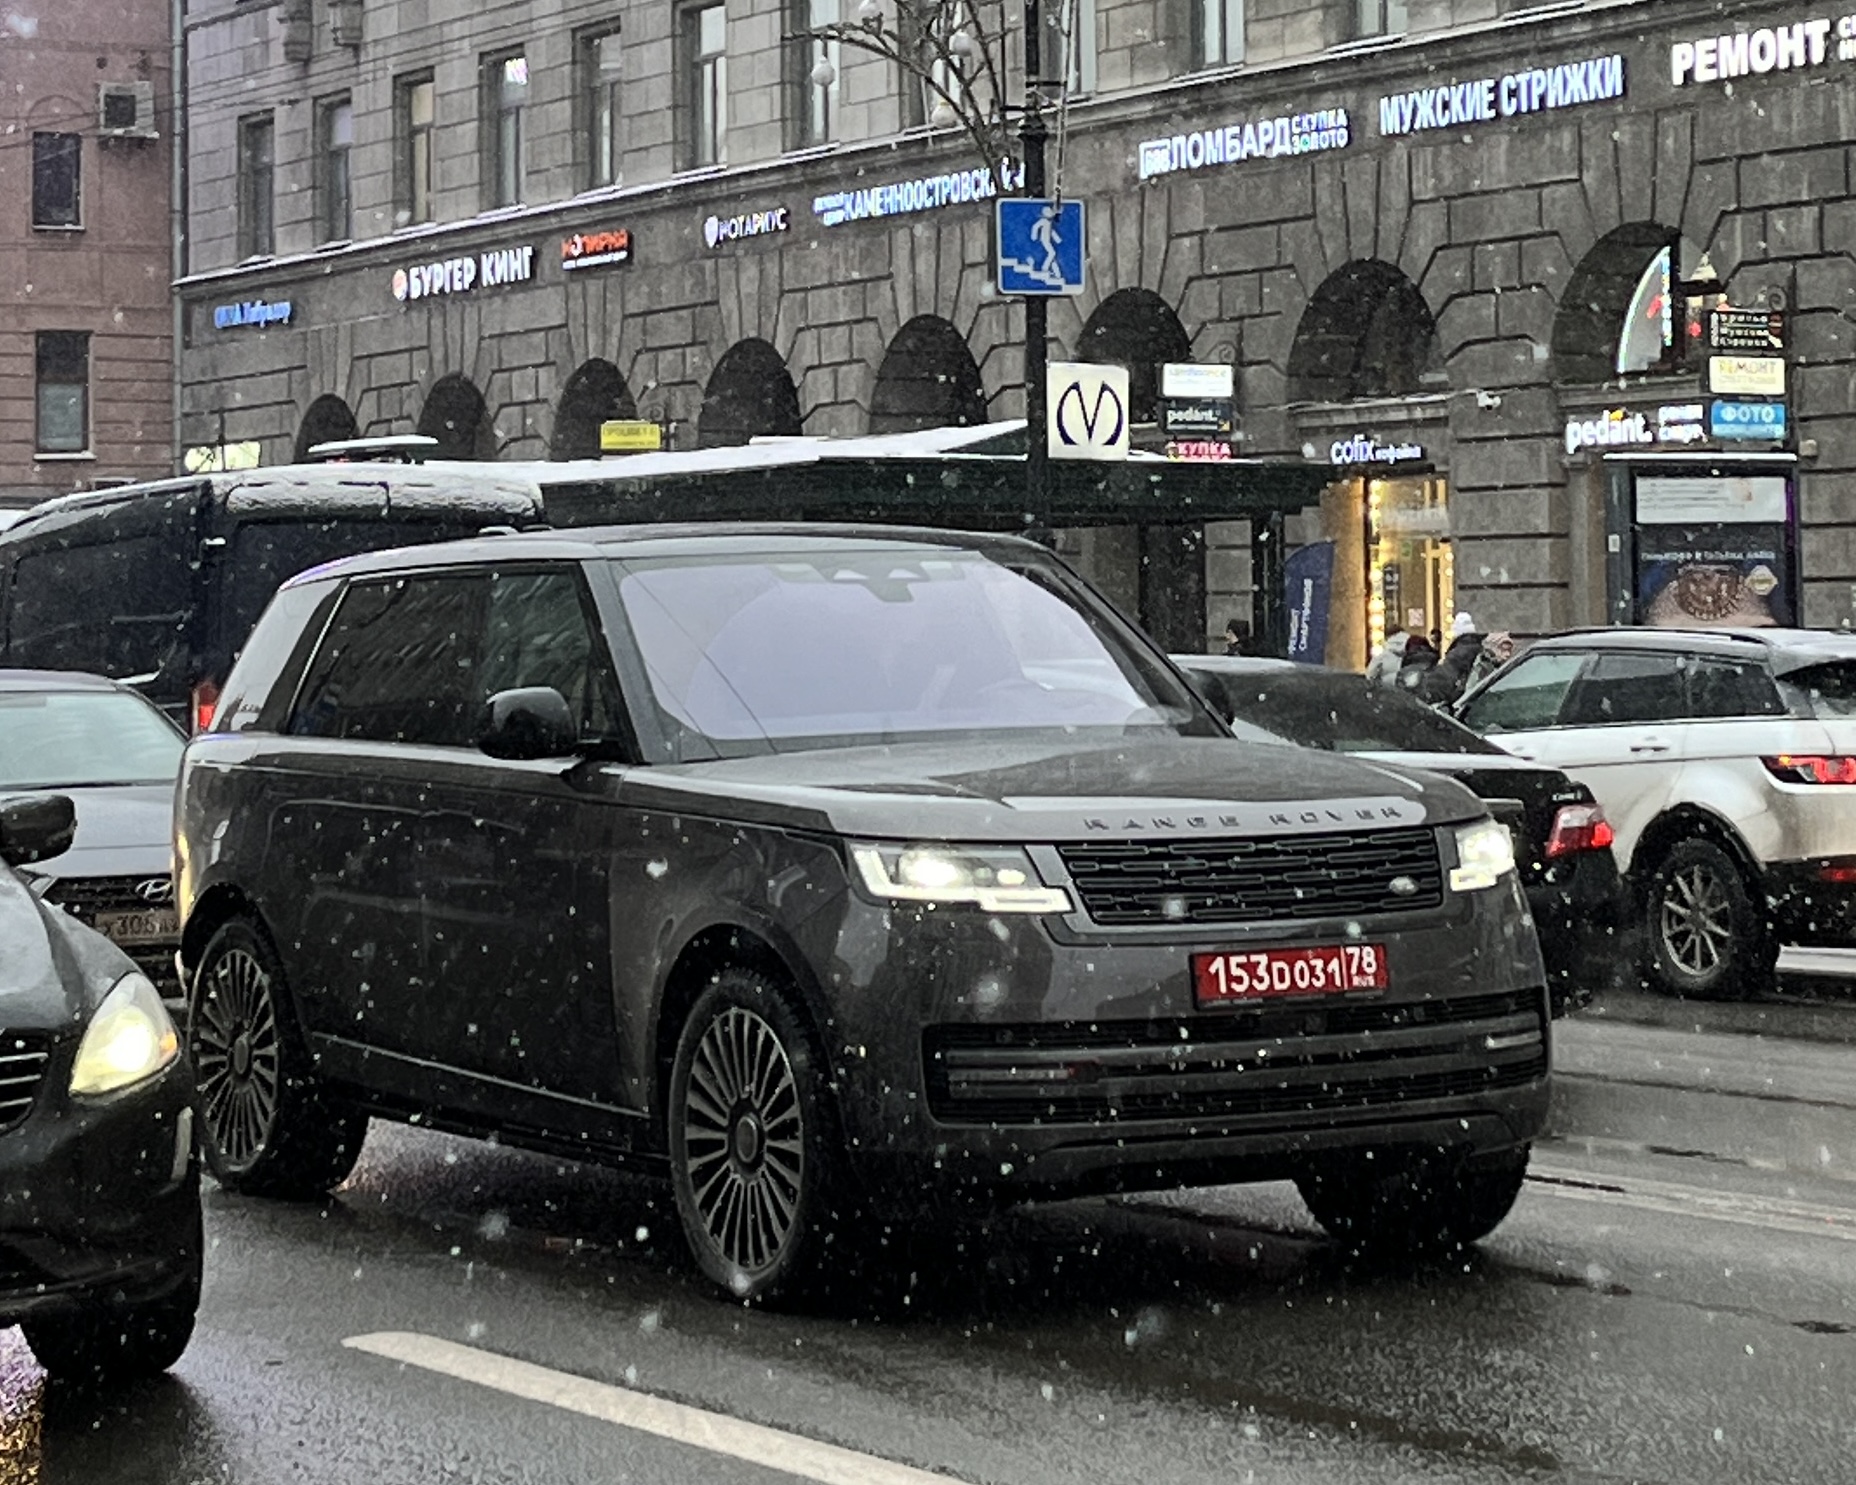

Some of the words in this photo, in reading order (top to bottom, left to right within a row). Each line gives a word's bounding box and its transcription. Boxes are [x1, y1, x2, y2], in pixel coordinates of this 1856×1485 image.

[1672, 19, 1831, 86] РЕМОНТ
[1379, 79, 1497, 136] МУЖСКИЕ
[1500, 54, 1624, 117] СТРИЖКИ
[1291, 108, 1348, 134] СКУПКА
[1170, 117, 1293, 171] ЛОМБАРД
[1291, 128, 1349, 155] ЗОЛОТО
[409, 256, 477, 300] БУРГЕР
[481, 245, 533, 288] КИНГ
[1720, 405, 1776, 424] ФОТО
[1083, 816, 1241, 832] RANGE
[1268, 805, 1404, 826] ROVER
[1345, 945, 1378, 975] 78
